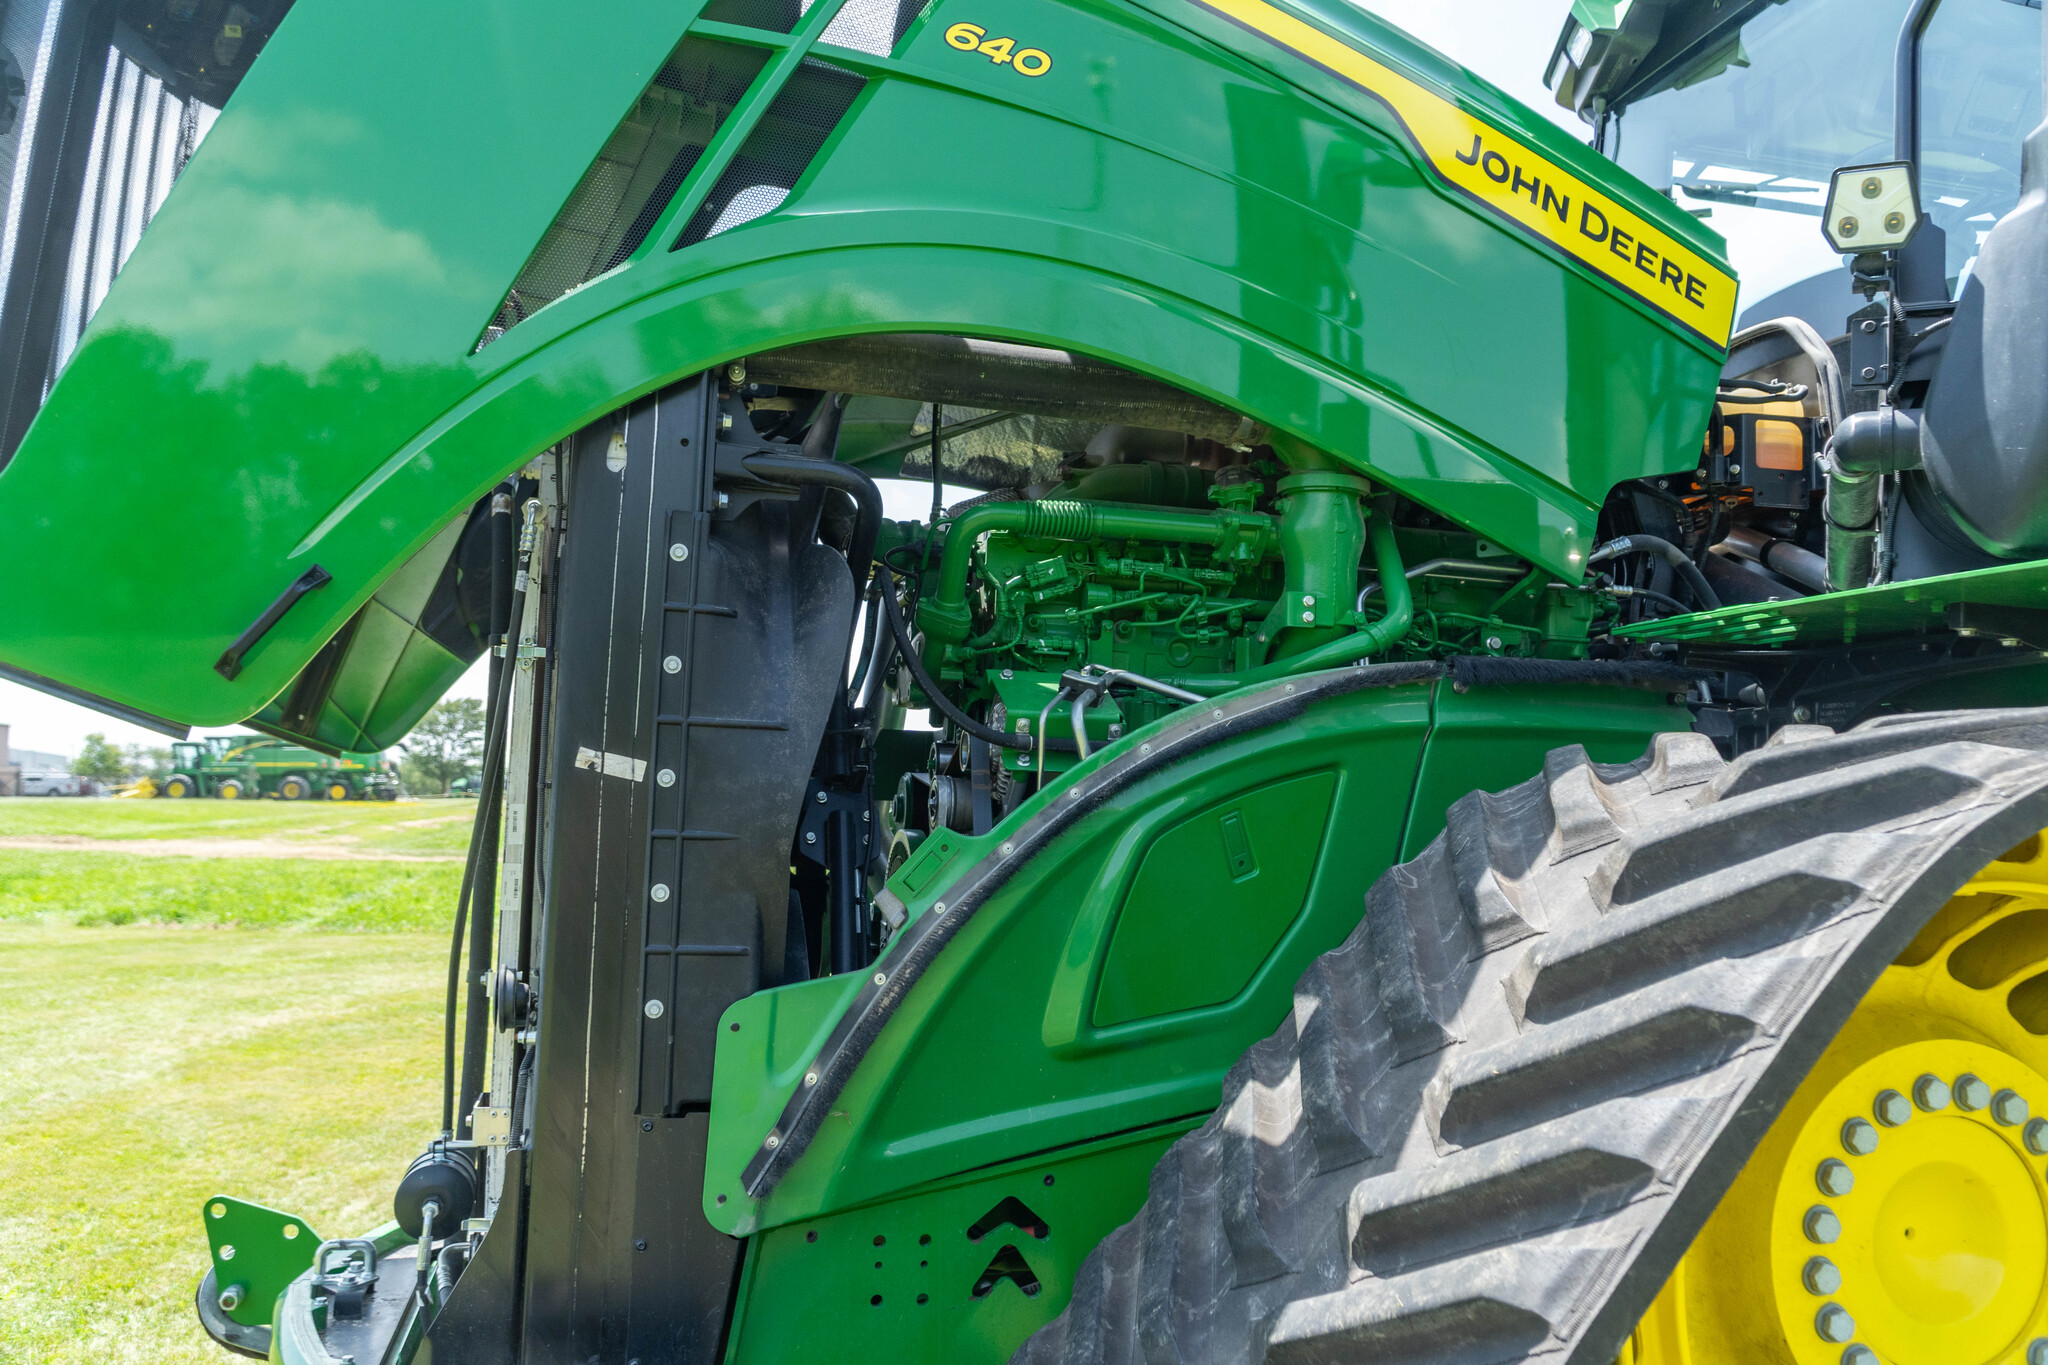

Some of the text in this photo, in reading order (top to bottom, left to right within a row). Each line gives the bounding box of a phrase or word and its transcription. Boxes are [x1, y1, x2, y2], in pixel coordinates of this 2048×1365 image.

[943, 21, 1053, 78] 640
[1455, 133, 1708, 310] JOHN DEERE
